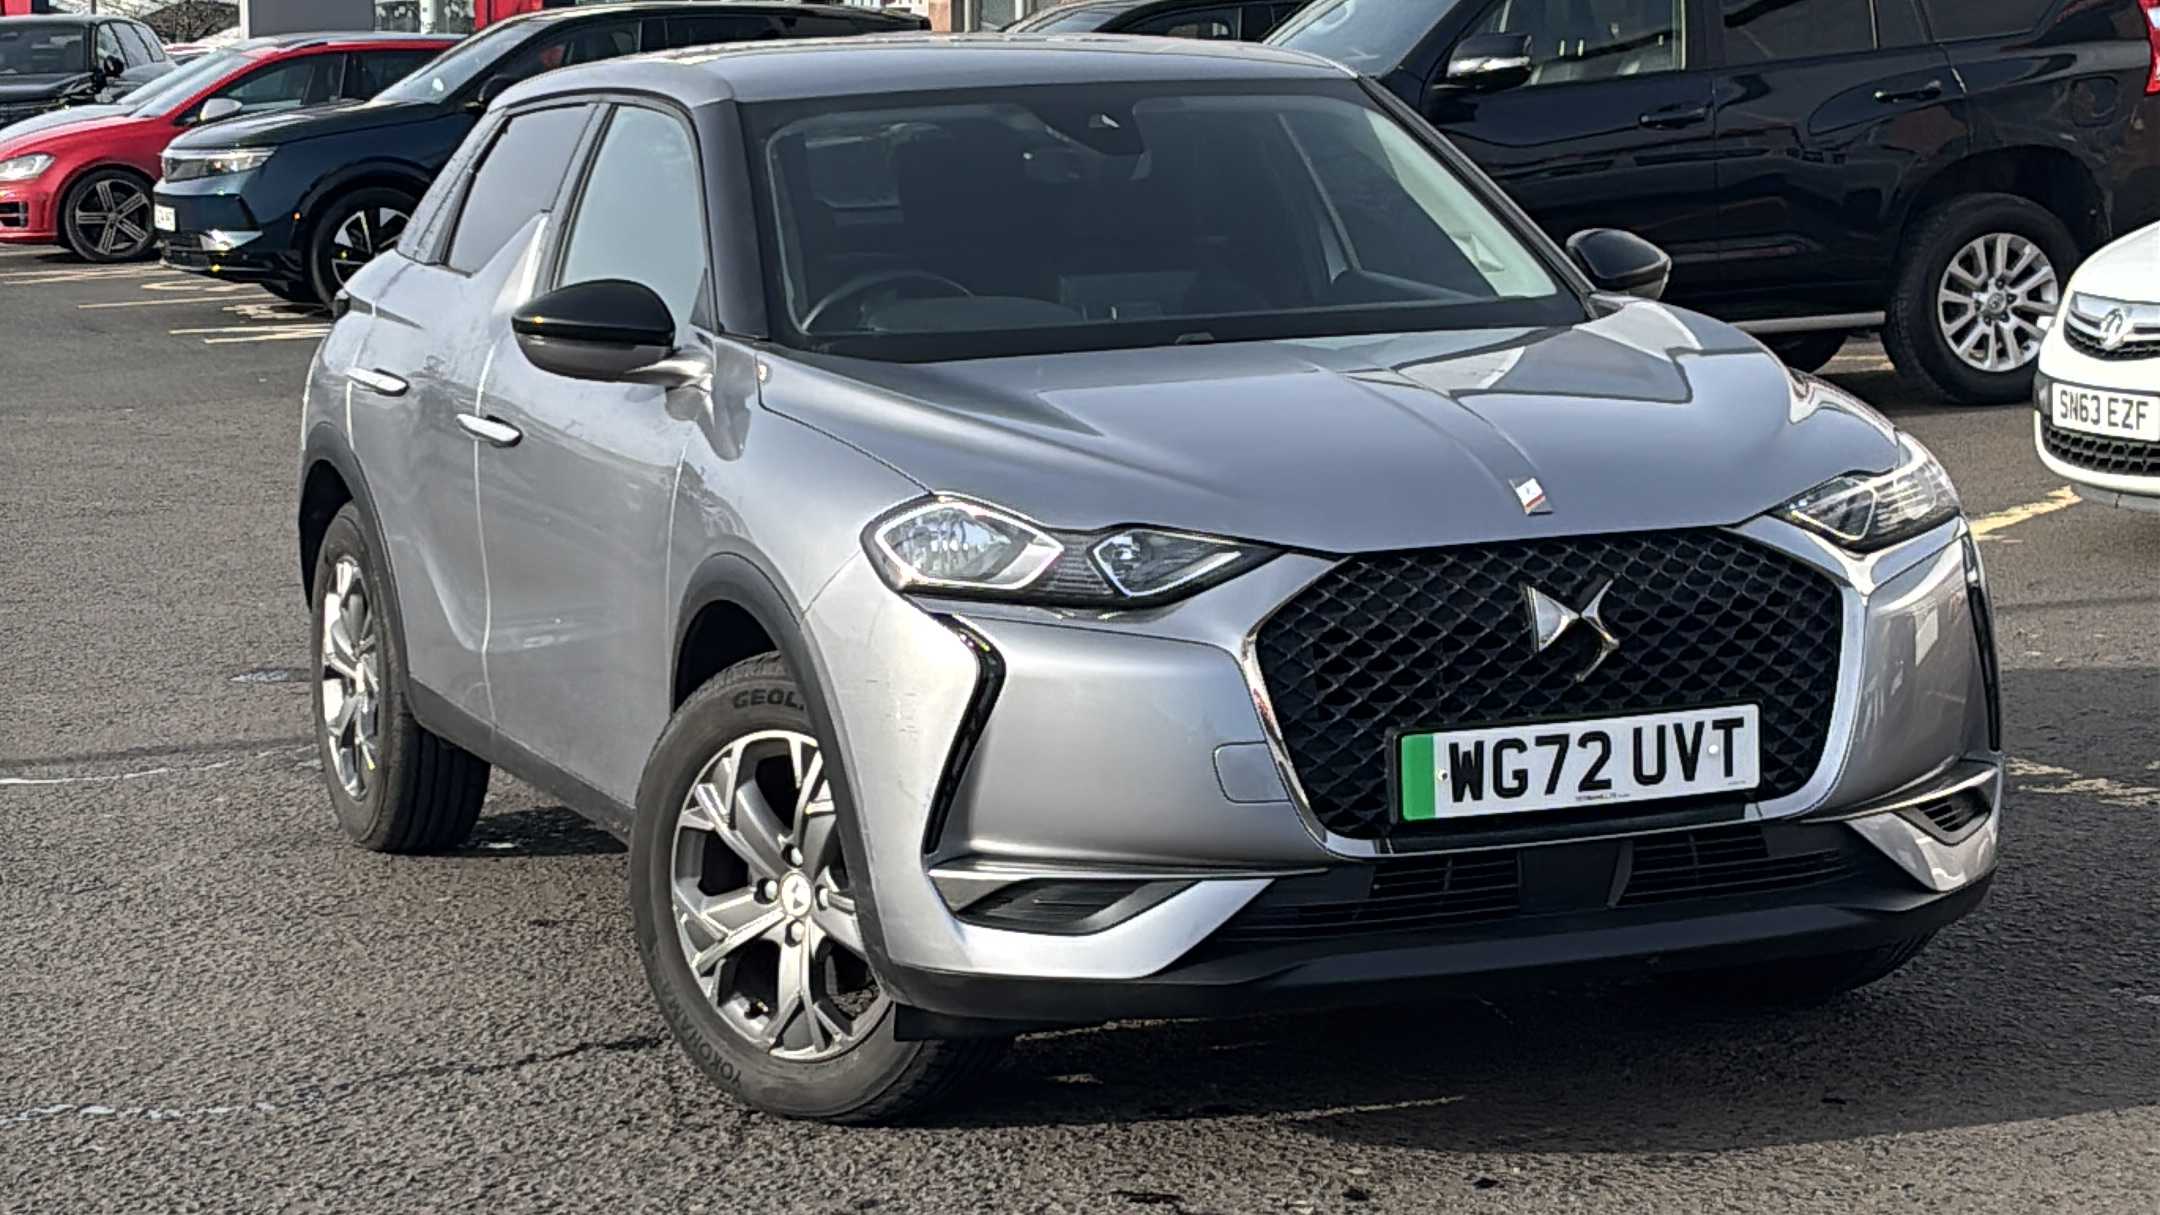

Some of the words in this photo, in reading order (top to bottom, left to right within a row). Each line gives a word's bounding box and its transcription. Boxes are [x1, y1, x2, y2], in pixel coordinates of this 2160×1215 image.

[2060, 390, 2101, 425] SN63
[2107, 398, 2149, 430] EZF
[734, 688, 804, 710] GEOL
[1448, 730, 1612, 802] WG72
[1632, 717, 1745, 786] UVT
